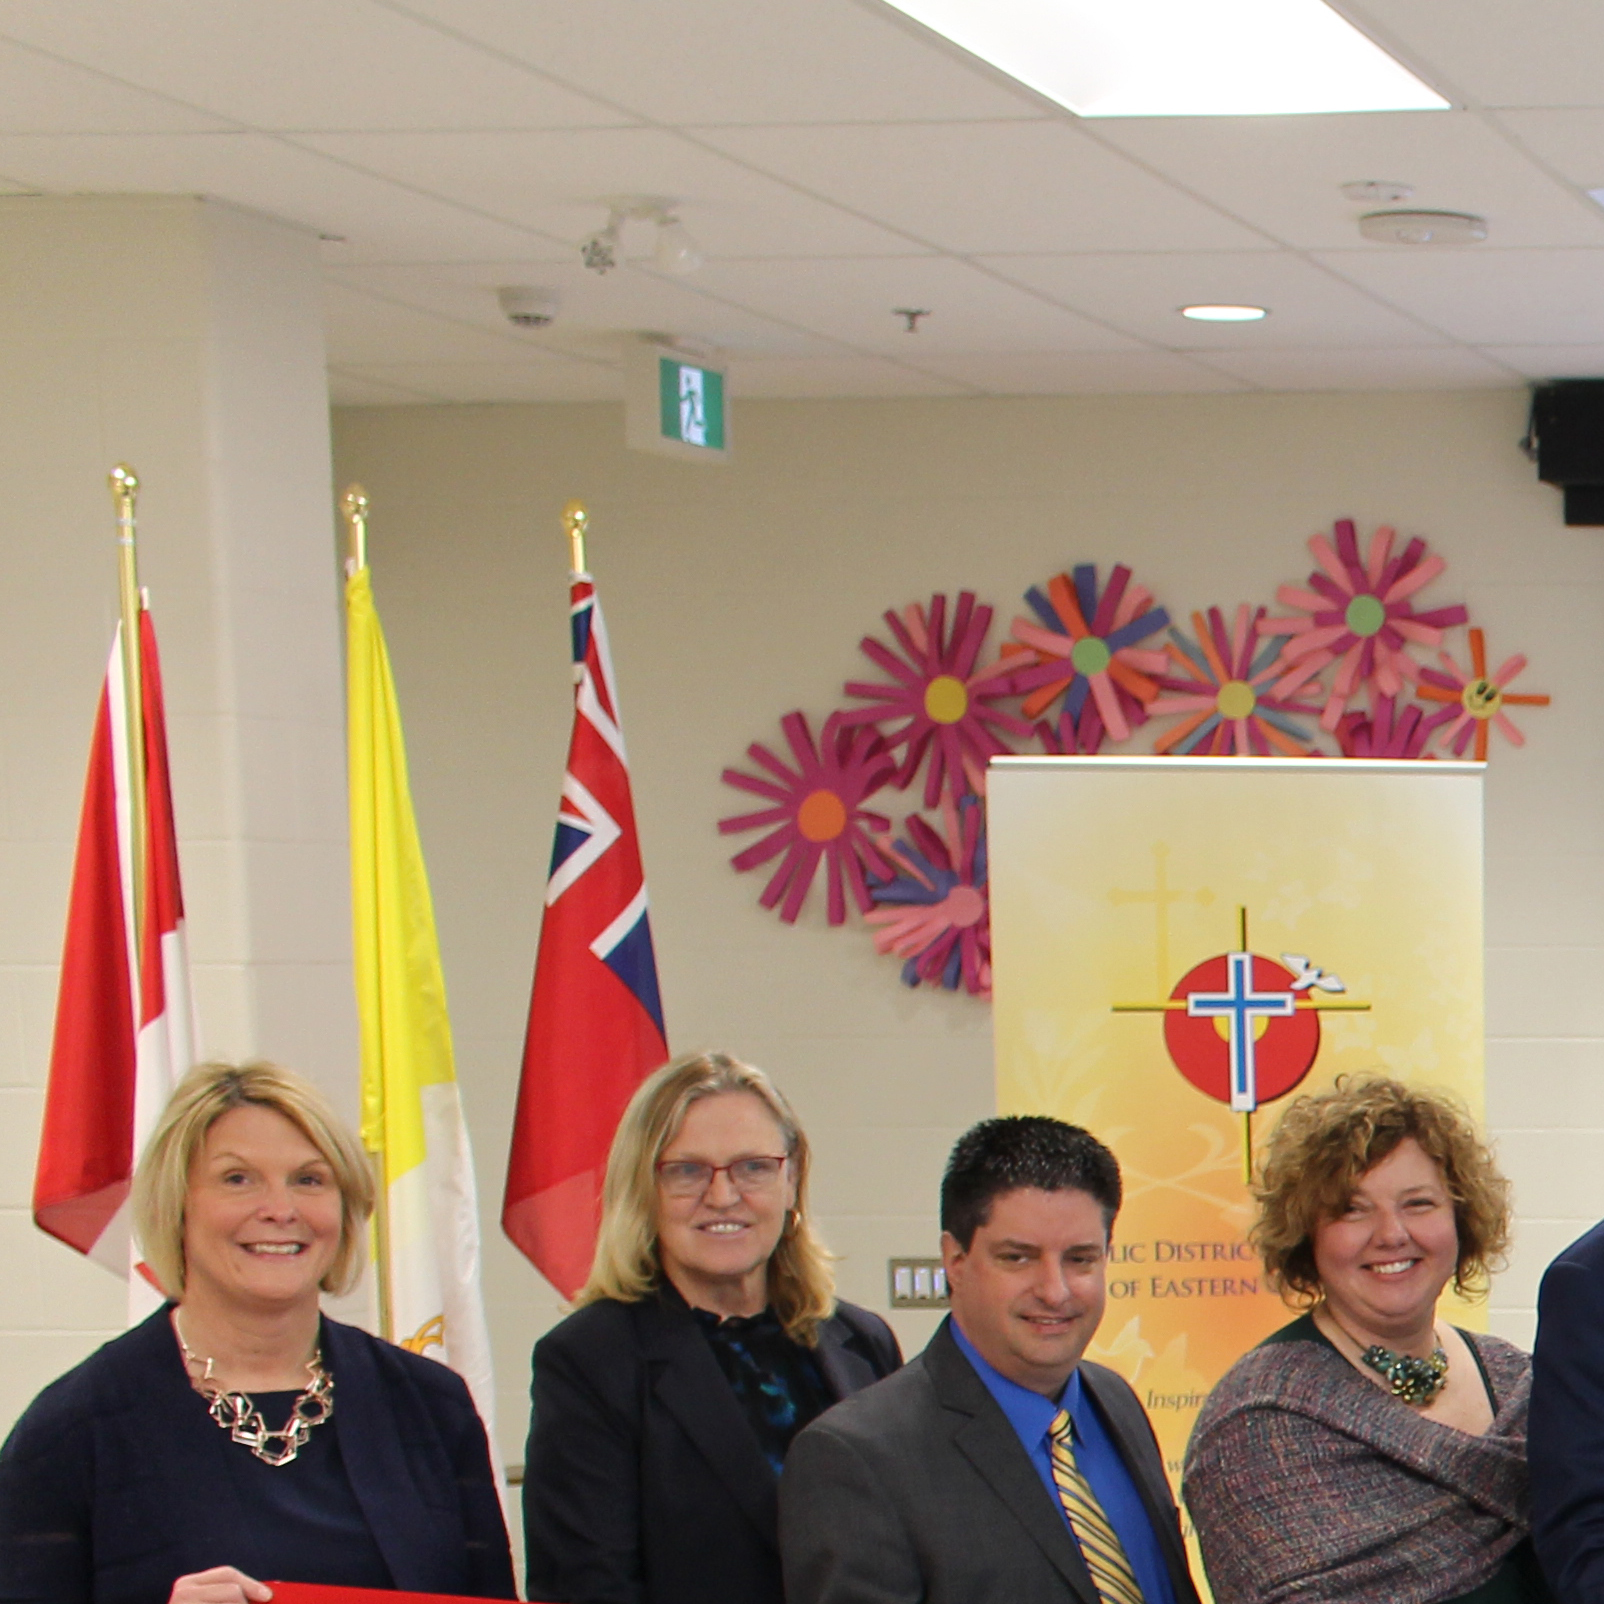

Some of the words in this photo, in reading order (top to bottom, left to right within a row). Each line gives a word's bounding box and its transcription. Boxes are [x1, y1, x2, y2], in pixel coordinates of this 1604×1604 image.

[1154, 1240, 1255, 1263] DISTRIC
[1109, 1279, 1140, 1300] OF
[1151, 1275, 1258, 1299] EASTERN
[1146, 1387, 1202, 1412] Inspir
